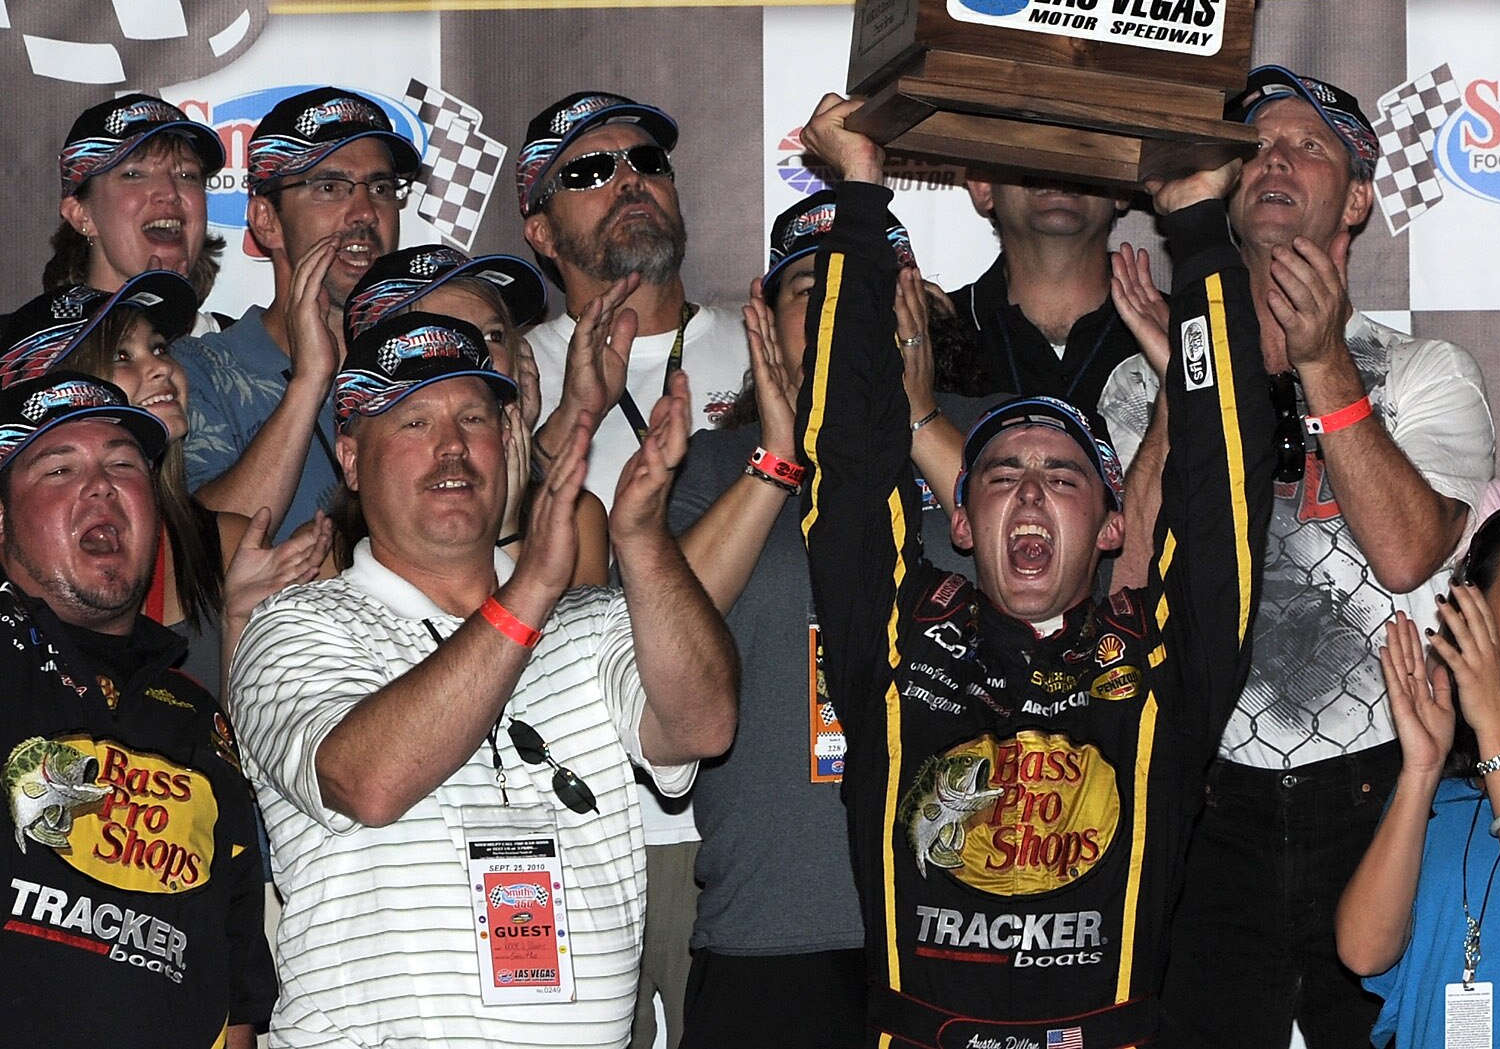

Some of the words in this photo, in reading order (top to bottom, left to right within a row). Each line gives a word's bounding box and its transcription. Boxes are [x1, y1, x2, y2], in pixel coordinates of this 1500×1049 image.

[1028, 8, 1099, 32] MOTOR
[1110, 20, 1214, 48] SPEEDWAY
[828, 744, 841, 753] 228
[990, 741, 1083, 786] Bass
[100, 745, 193, 803] Bass
[100, 787, 170, 835] Pro
[990, 784, 1063, 830] Pro
[93, 822, 203, 888] Shops
[489, 864, 512, 872] SEPT.
[514, 864, 525, 872] 25,
[527, 863, 545, 871] 2010
[985, 823, 1100, 880] Shops
[10, 878, 188, 969] TRACKER
[494, 925, 552, 938] GUEST
[916, 905, 1103, 951] TRACKER
[109, 943, 184, 985] boats
[514, 969, 529, 978] LAS
[530, 968, 556, 978] VEGAS
[1013, 950, 1104, 969] boats
[966, 1033, 1002, 1049] Austin
[1005, 1035, 1040, 1049] Dillon
